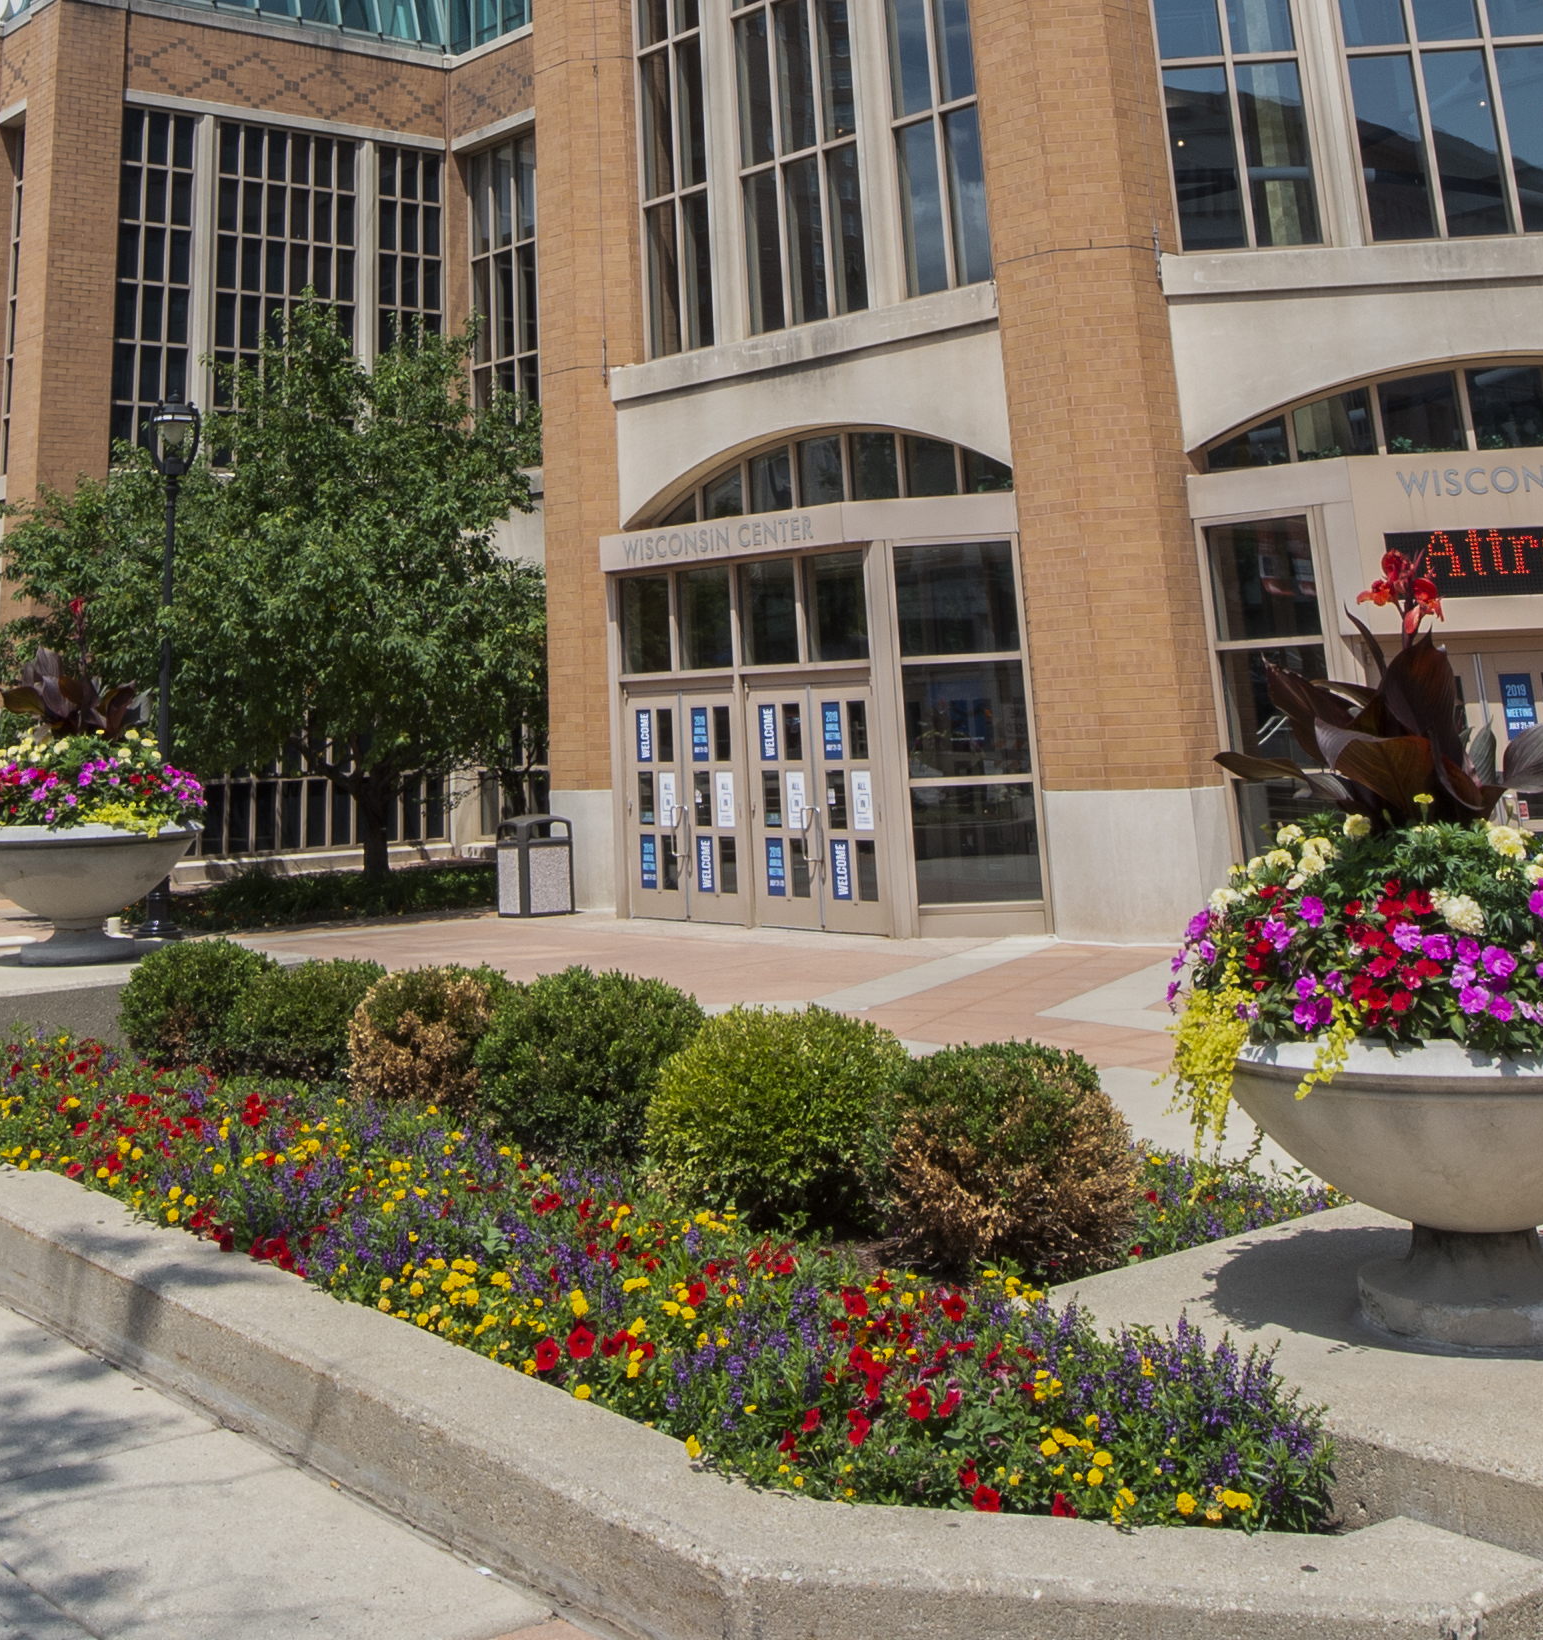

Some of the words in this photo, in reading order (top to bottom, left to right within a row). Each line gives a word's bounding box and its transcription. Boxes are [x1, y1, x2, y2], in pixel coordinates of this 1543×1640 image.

[622, 526, 730, 562] WISCONSIN
[737, 515, 815, 548] CENTER
[1505, 683, 1527, 697] 2019
[1506, 707, 1533, 718] MEETING
[639, 713, 650, 759] WELCOME
[762, 708, 775, 757] WELCOME
[700, 840, 712, 888] WELCOME
[834, 843, 849, 896] WELCOME
